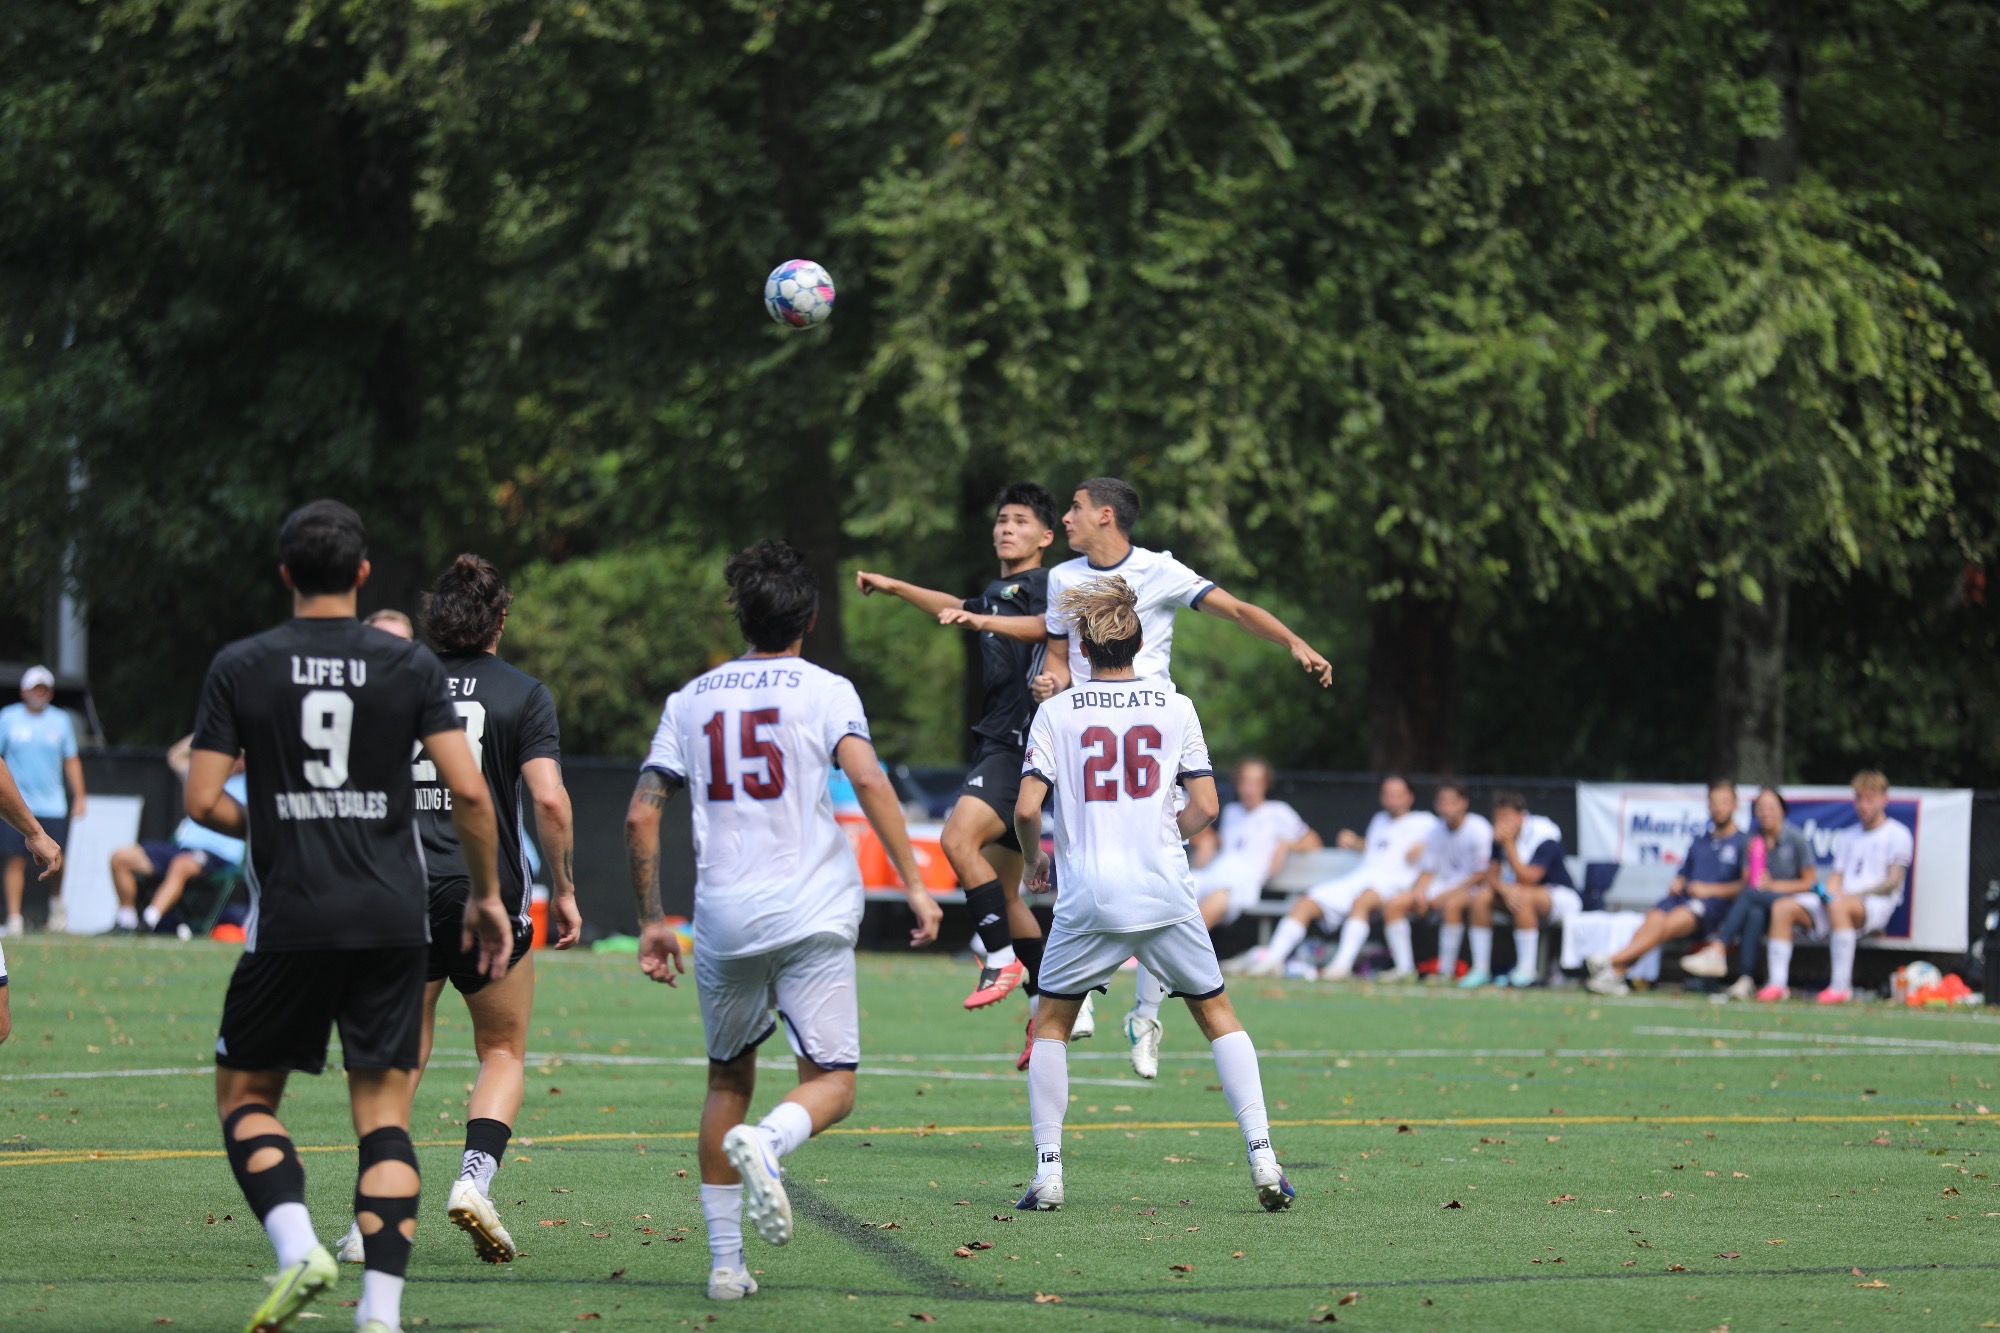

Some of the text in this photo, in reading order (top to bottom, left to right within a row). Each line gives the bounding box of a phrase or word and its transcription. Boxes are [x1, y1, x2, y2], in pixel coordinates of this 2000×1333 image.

[291, 655, 367, 687] LIFE U
[694, 670, 803, 696] BOBCATS
[1071, 690, 1166, 710] BOBCATS
[301, 689, 354, 789] 9
[703, 707, 786, 802] 15
[1080, 724, 1163, 803] 26
[1042, 1151, 1060, 1163] FS
[1249, 1138, 1269, 1151] FS
